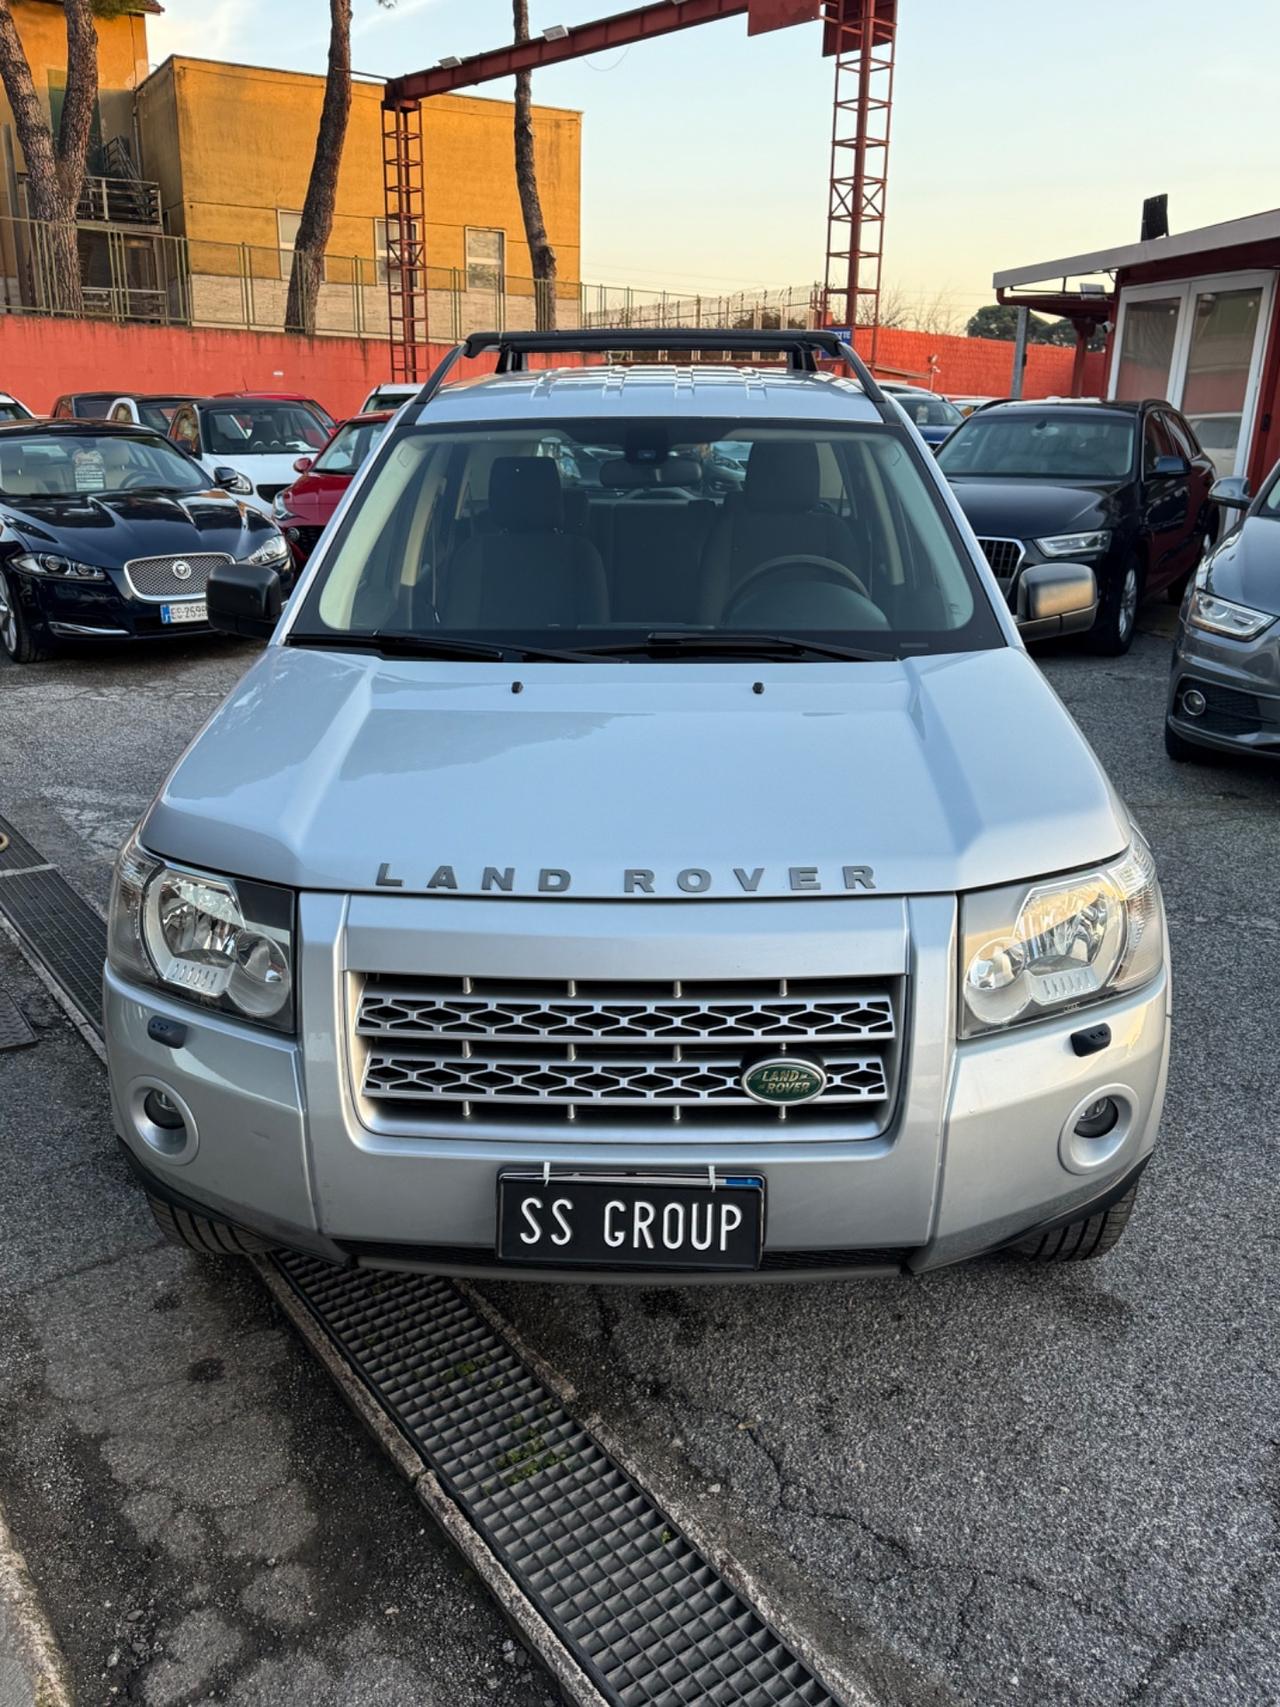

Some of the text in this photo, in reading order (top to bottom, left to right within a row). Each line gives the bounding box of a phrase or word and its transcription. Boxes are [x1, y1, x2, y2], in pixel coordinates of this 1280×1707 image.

[376, 863, 876, 893] LAND ROVER
[762, 1070, 800, 1081] LAND
[766, 1082, 810, 1093] ROVER
[520, 1198, 742, 1251] SS GROUP
